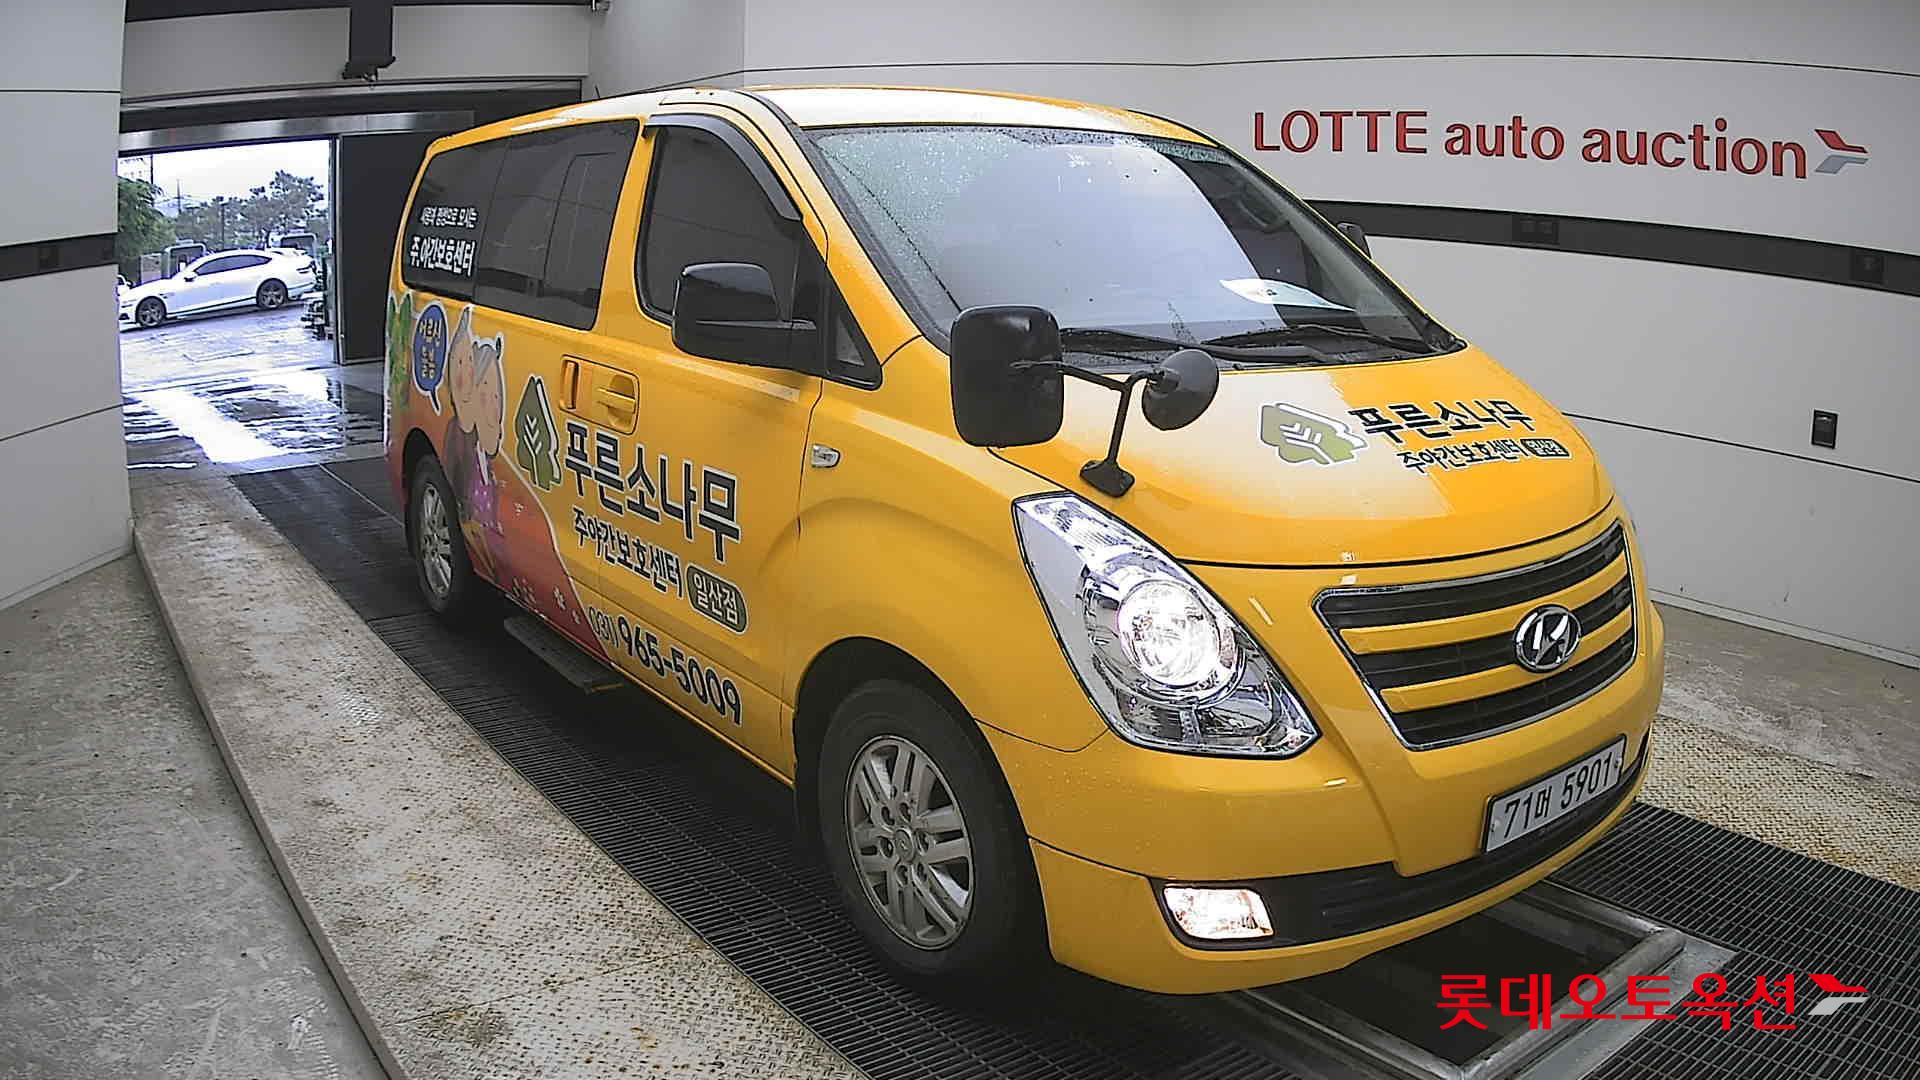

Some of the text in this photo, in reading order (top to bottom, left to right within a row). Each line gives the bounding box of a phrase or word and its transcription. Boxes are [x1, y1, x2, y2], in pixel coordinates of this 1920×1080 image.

[1254, 110, 1808, 179] LOTTE auto auction
[1348, 400, 1536, 444] 푸른소나무
[1397, 438, 1528, 474] 주야간보호센터
[565, 420, 741, 563] 푸른소나무
[572, 506, 741, 627] 주야간보호센터 일산점
[1504, 752, 1612, 838] 71머 5901
